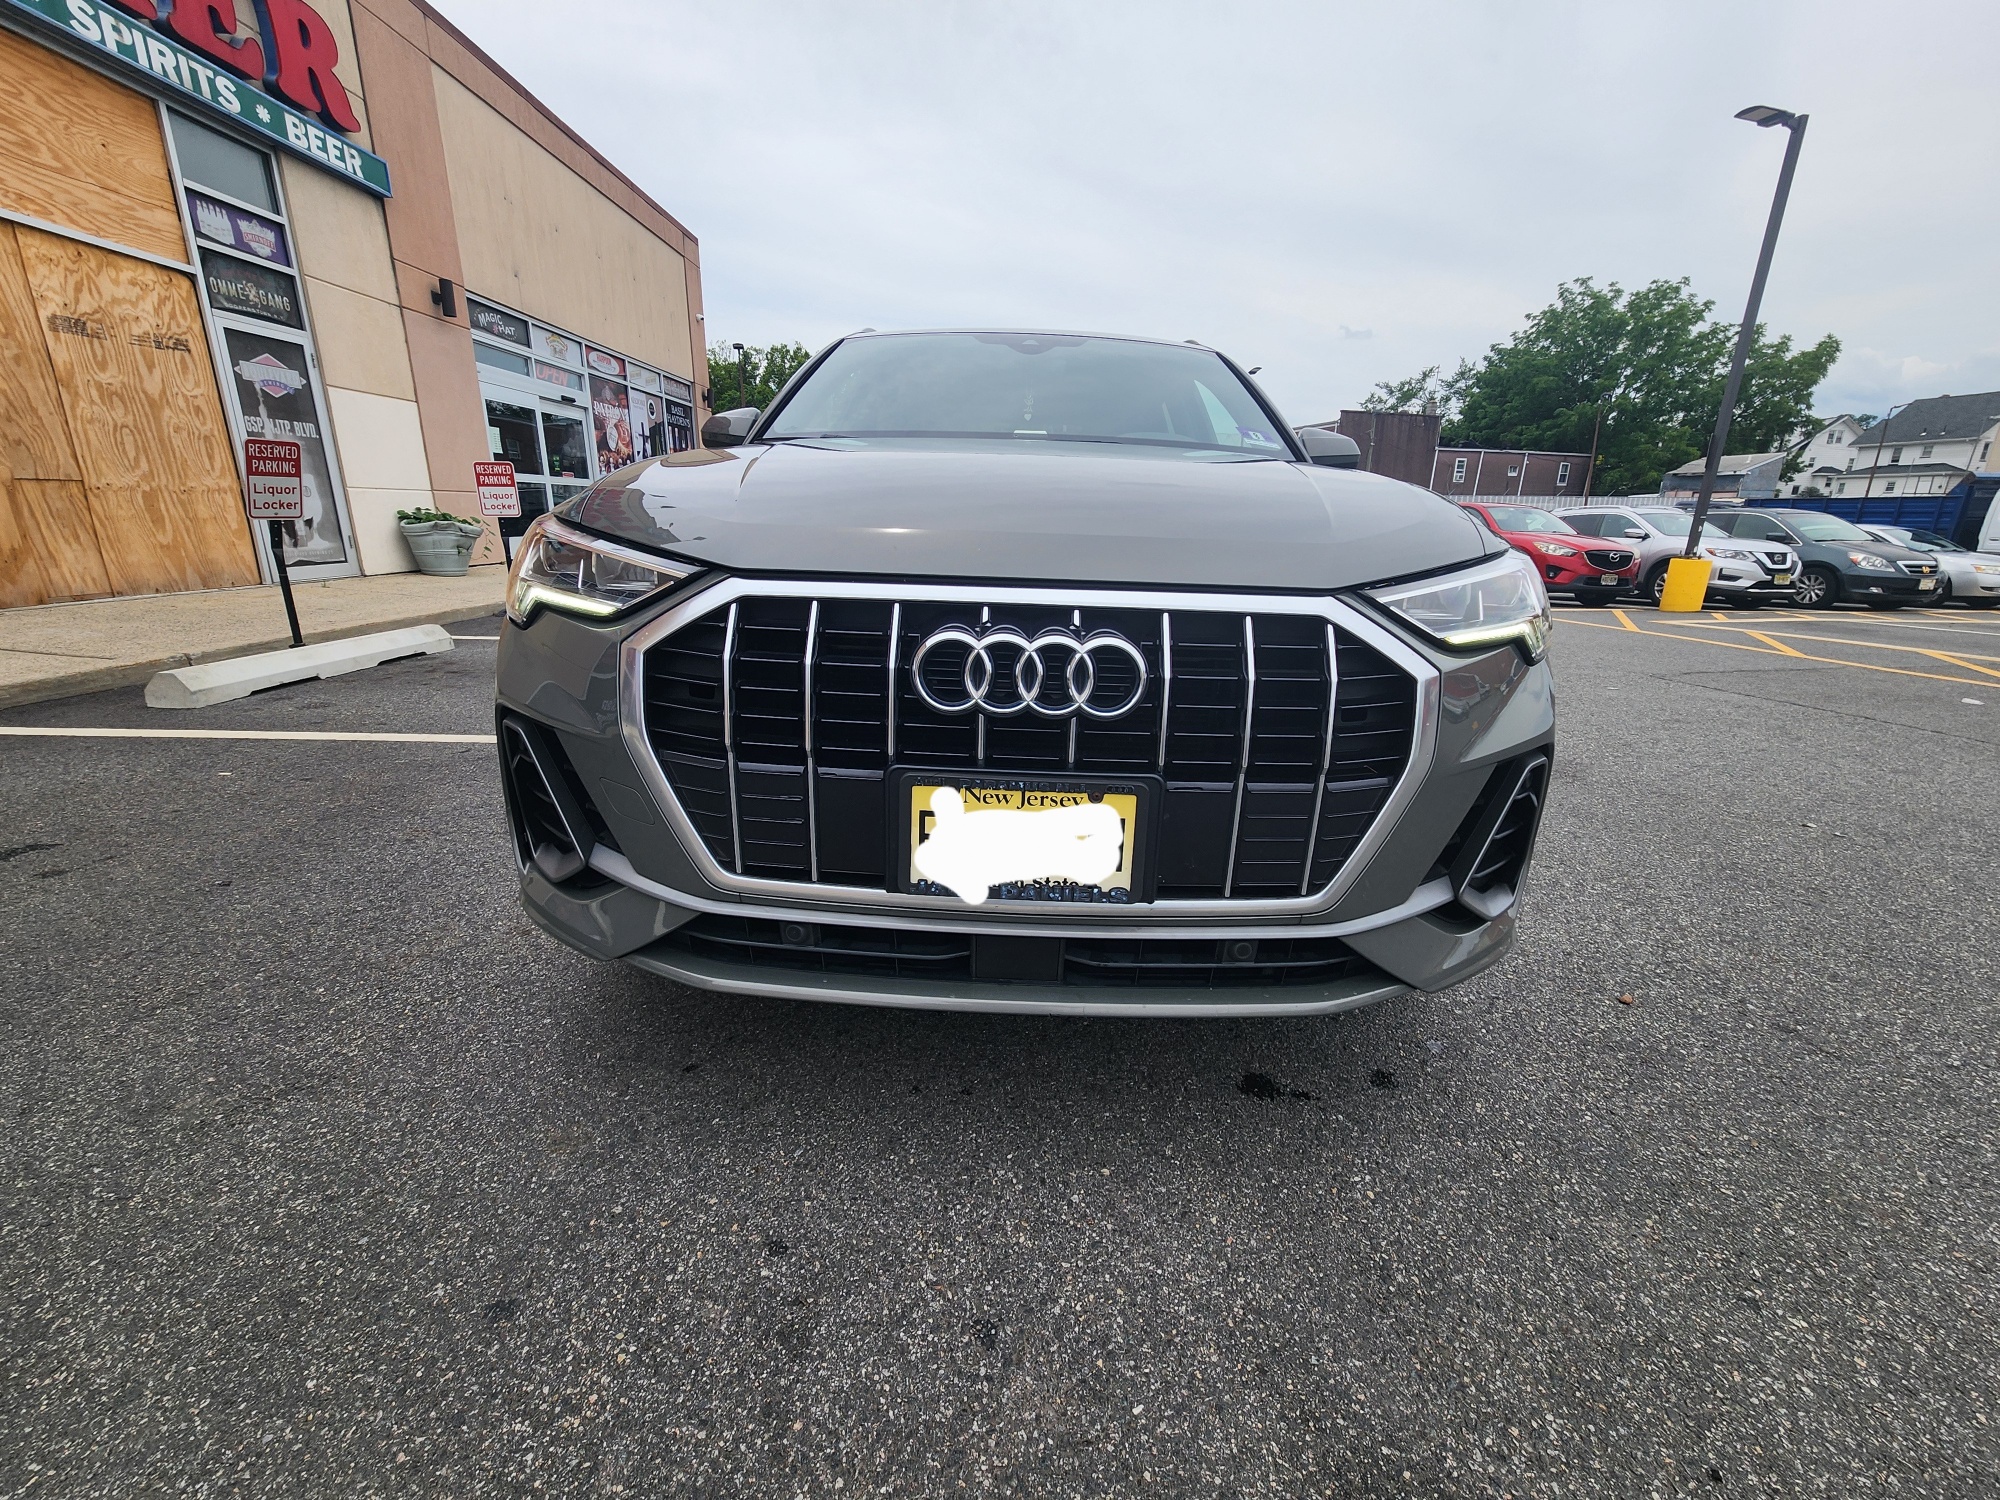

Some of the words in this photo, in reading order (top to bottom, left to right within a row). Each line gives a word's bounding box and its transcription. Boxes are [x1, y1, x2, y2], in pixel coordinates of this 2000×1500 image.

[66, 0, 242, 114] SPIRITS
[284, 112, 364, 179] BEER
[478, 312, 503, 327] MAGIC
[498, 324, 516, 336] HAT
[535, 363, 569, 387] OPEN
[293, 421, 320, 438] BLVD.
[248, 443, 298, 459] RESERVED
[252, 459, 296, 474] PARKING
[475, 464, 512, 475] RESERVED
[480, 475, 512, 485] PARKING
[253, 482, 298, 497] Liquor
[482, 491, 514, 501] Liquor
[253, 499, 299, 510] Locker
[483, 502, 517, 510] Locker
[962, 786, 1015, 805] New
[1016, 782, 1084, 810] Jersey
